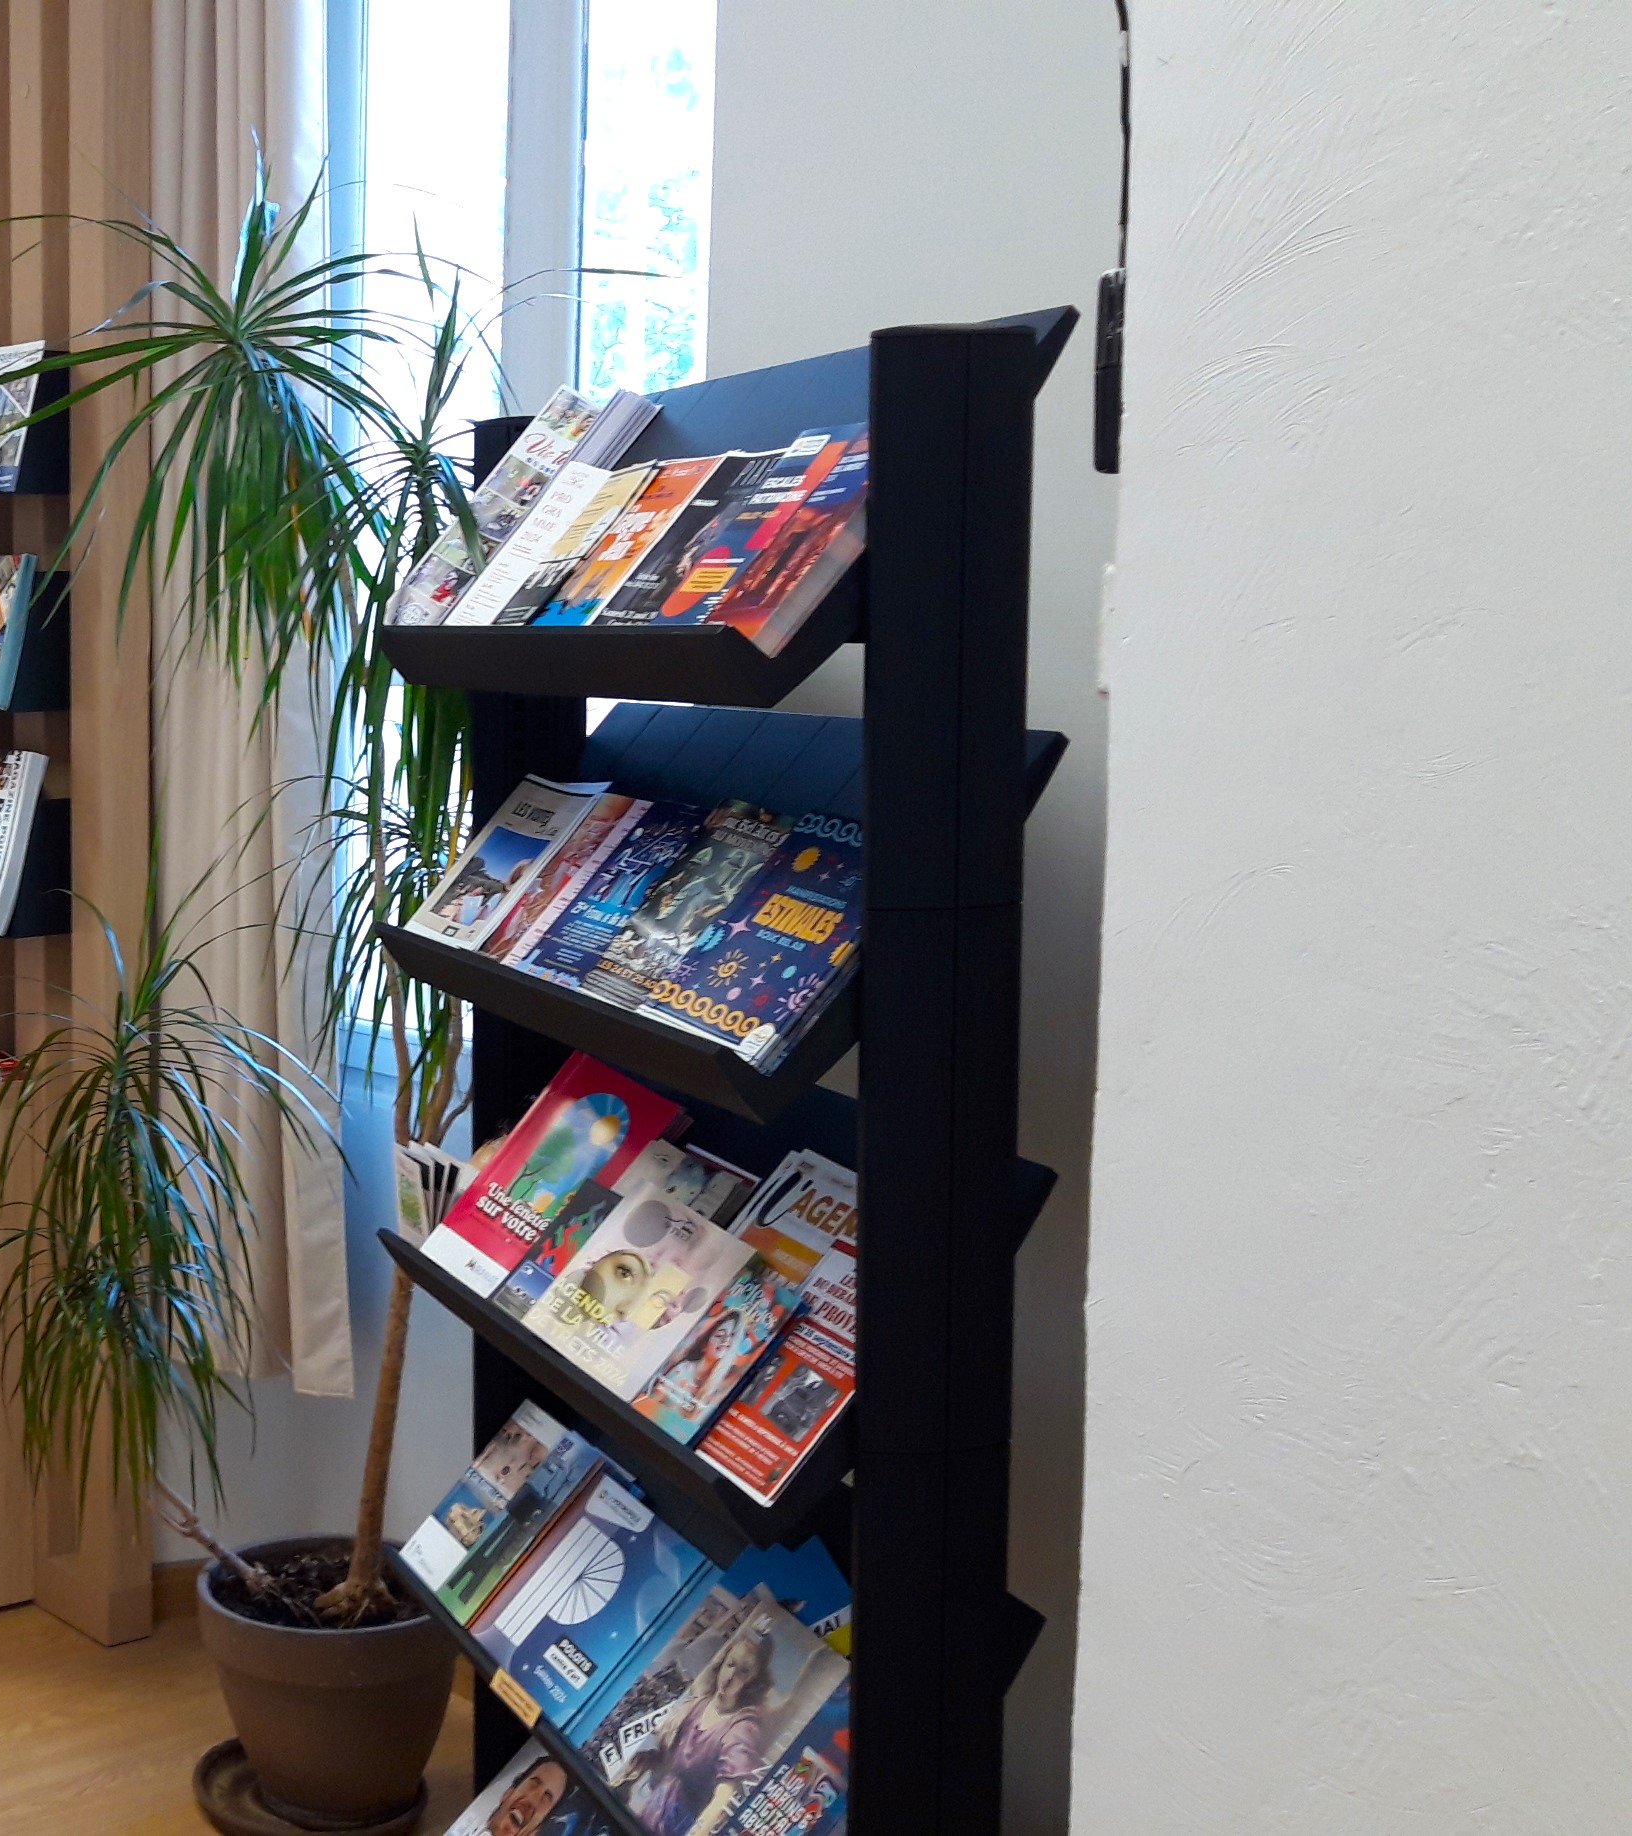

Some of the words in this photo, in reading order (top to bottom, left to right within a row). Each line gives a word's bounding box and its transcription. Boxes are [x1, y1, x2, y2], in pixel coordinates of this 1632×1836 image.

[752, 893, 845, 945] ESTIVALES
[488, 1181, 512, 1207] Une
[475, 1195, 504, 1217] sur
[501, 1210, 538, 1241] votre
[557, 1276, 612, 1326] AGENDA
[560, 1305, 584, 1328] LA
[623, 1708, 668, 1744] FRIC
